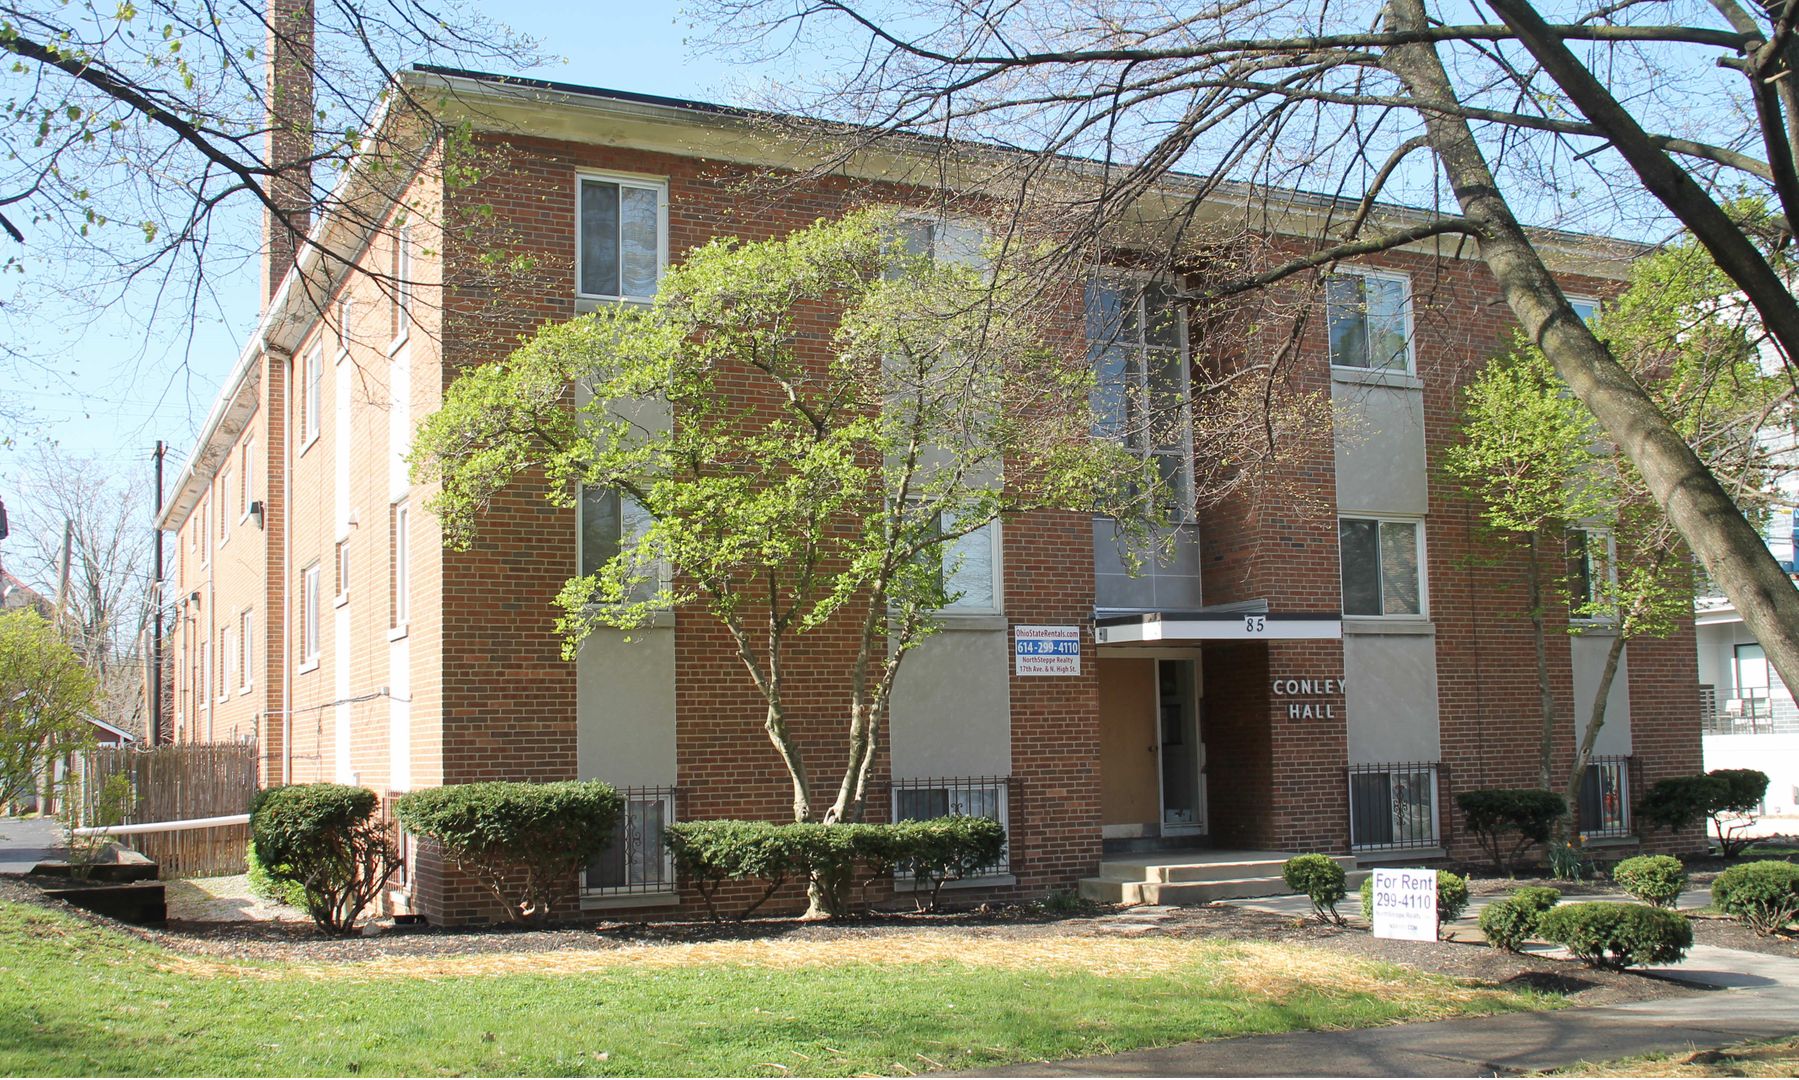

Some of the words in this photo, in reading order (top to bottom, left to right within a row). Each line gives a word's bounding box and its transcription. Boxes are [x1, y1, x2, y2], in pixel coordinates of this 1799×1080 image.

[1246, 618, 1264, 632] 85
[1016, 629, 1078, 638] OhioStateRentals.com
[1017, 642, 1078, 653] 614-299-4110
[1033, 665, 1044, 673] Ave.
[1050, 665, 1056, 673] N.
[1056, 665, 1068, 674] High
[1069, 665, 1077, 673] St.
[1273, 679, 1346, 695] CONLEY
[1289, 704, 1335, 719] HALL
[1376, 873, 1397, 888] For
[1401, 874, 1432, 890] Rent
[1376, 892, 1431, 909] 299-4110
